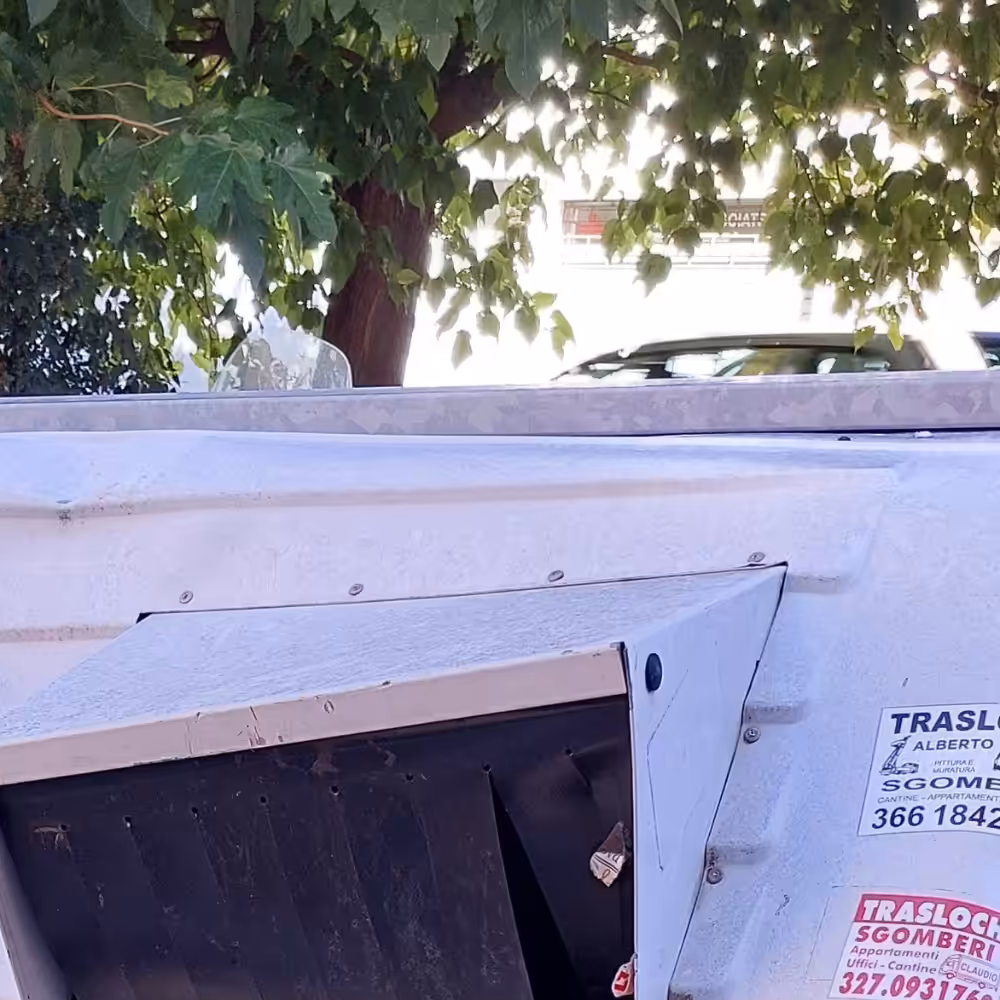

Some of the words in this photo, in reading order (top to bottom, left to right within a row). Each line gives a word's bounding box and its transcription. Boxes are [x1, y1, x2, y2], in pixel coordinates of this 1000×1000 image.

[891, 710, 1000, 734] TRASL
[912, 738, 994, 751] ALBERTO
[877, 795, 919, 804] CANTINE
[871, 805, 925, 829] 366
[850, 945, 939, 960] Appartamenti
[855, 925, 995, 962] SGOMBERI
[846, 958, 879, 969] Uffici
[888, 960, 937, 975] Cantine
[960, 963, 998, 982] CLAUDIO
